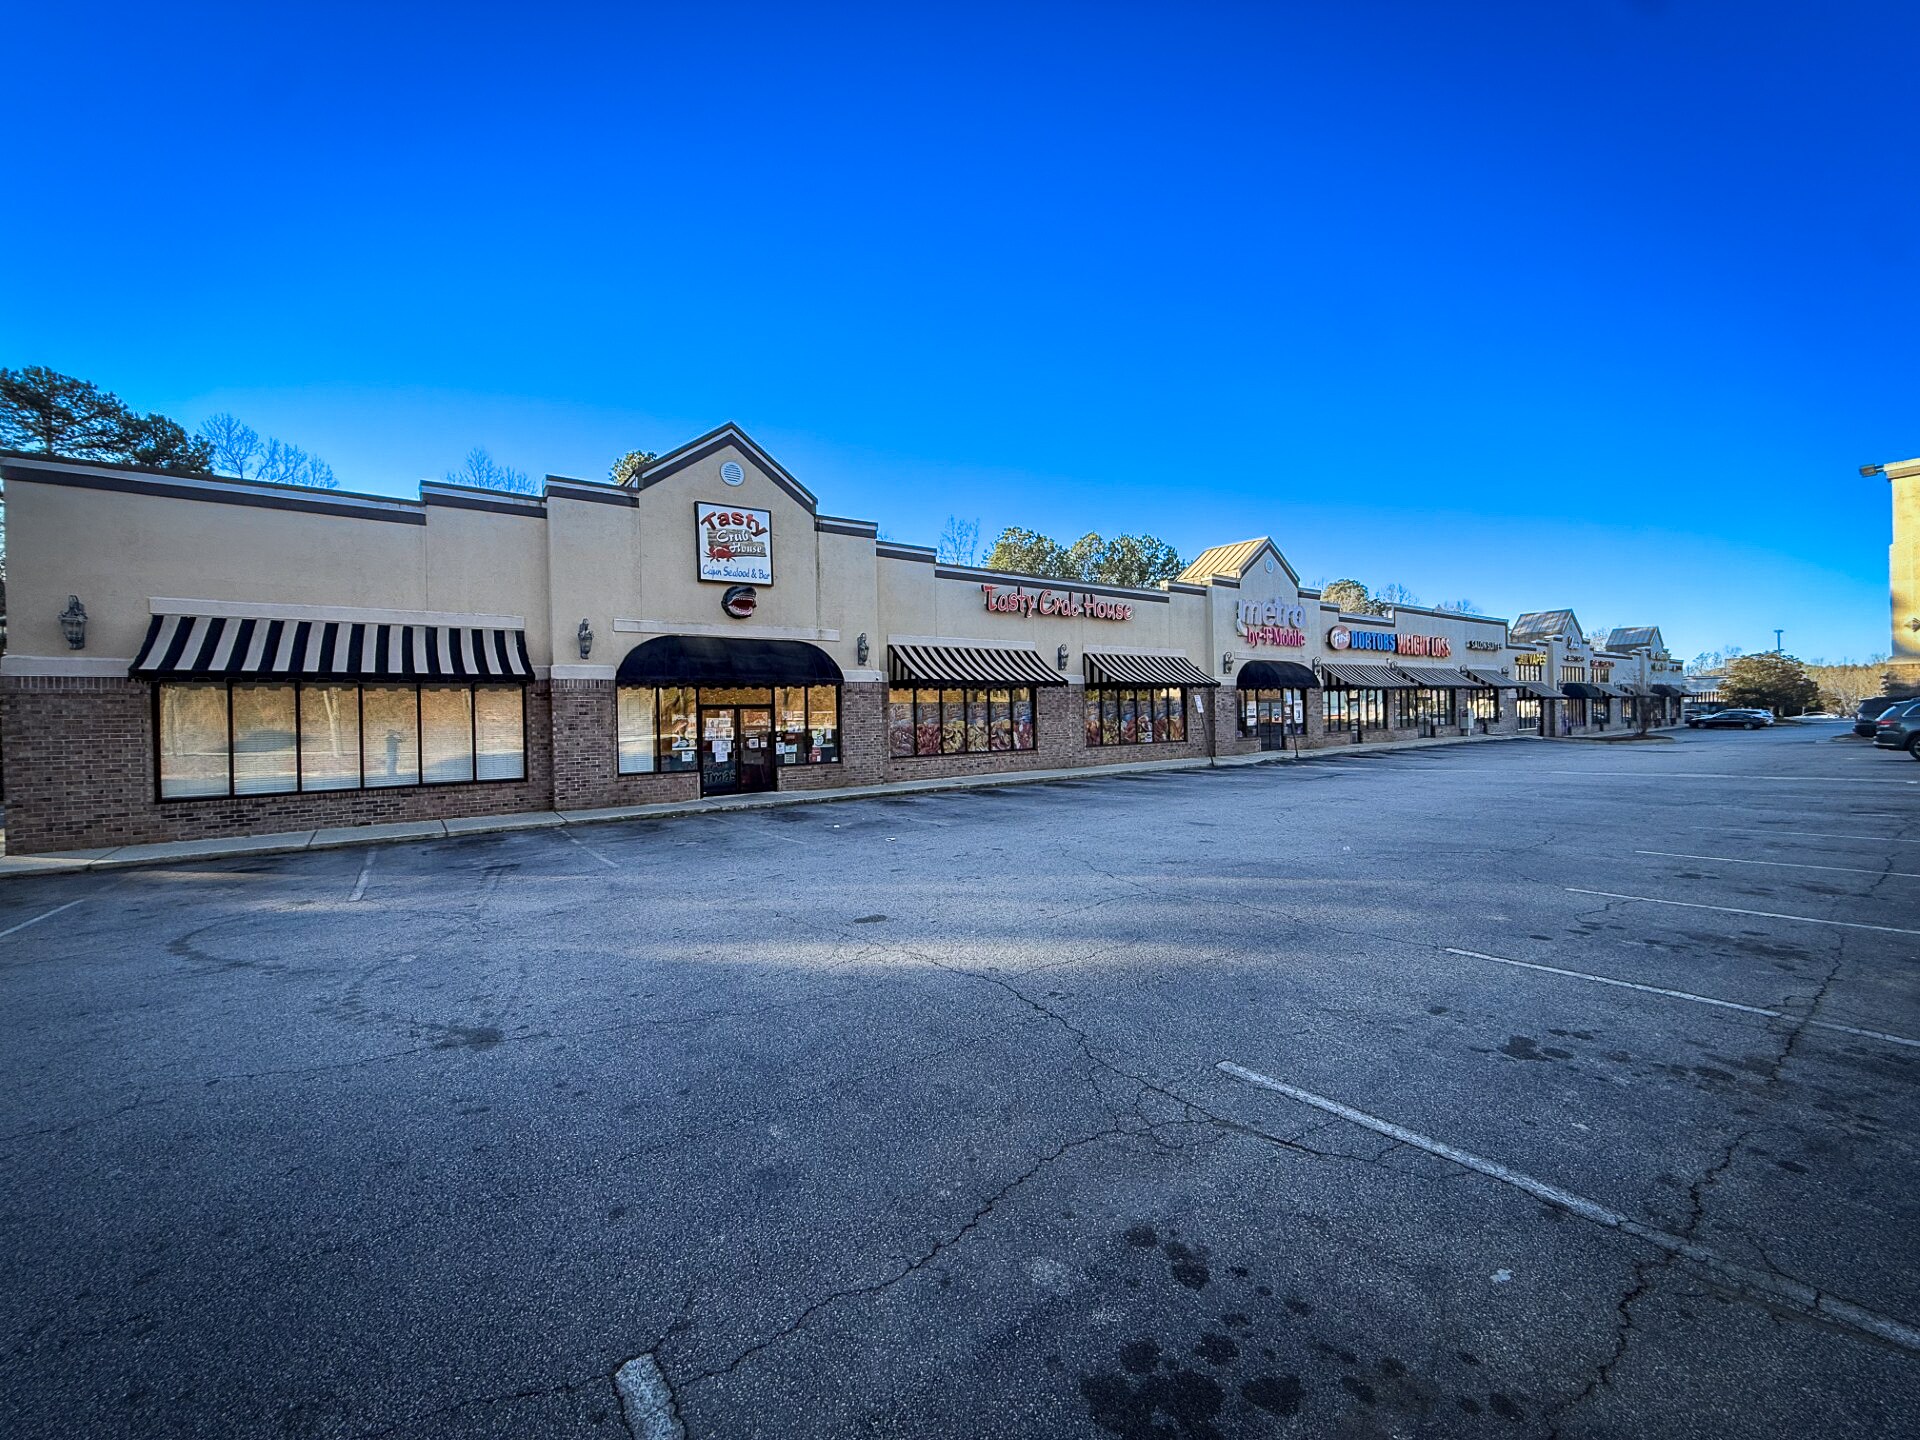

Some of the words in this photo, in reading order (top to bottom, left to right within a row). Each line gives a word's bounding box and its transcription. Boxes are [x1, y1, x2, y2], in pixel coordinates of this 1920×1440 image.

[700, 511, 768, 537] Tasty
[729, 541, 762, 554] House
[702, 564, 722, 579] Cajun
[723, 565, 750, 579] Seafood
[751, 568, 758, 579] &
[758, 569, 771, 580] Bar
[981, 583, 1037, 619] Tasty
[1038, 588, 1080, 617] Crab
[1082, 593, 1134, 621] House
[1236, 596, 1307, 629] metro
[1246, 625, 1259, 648] by
[1396, 633, 1431, 656] WEIGHT
[1431, 636, 1452, 658] LOSS
